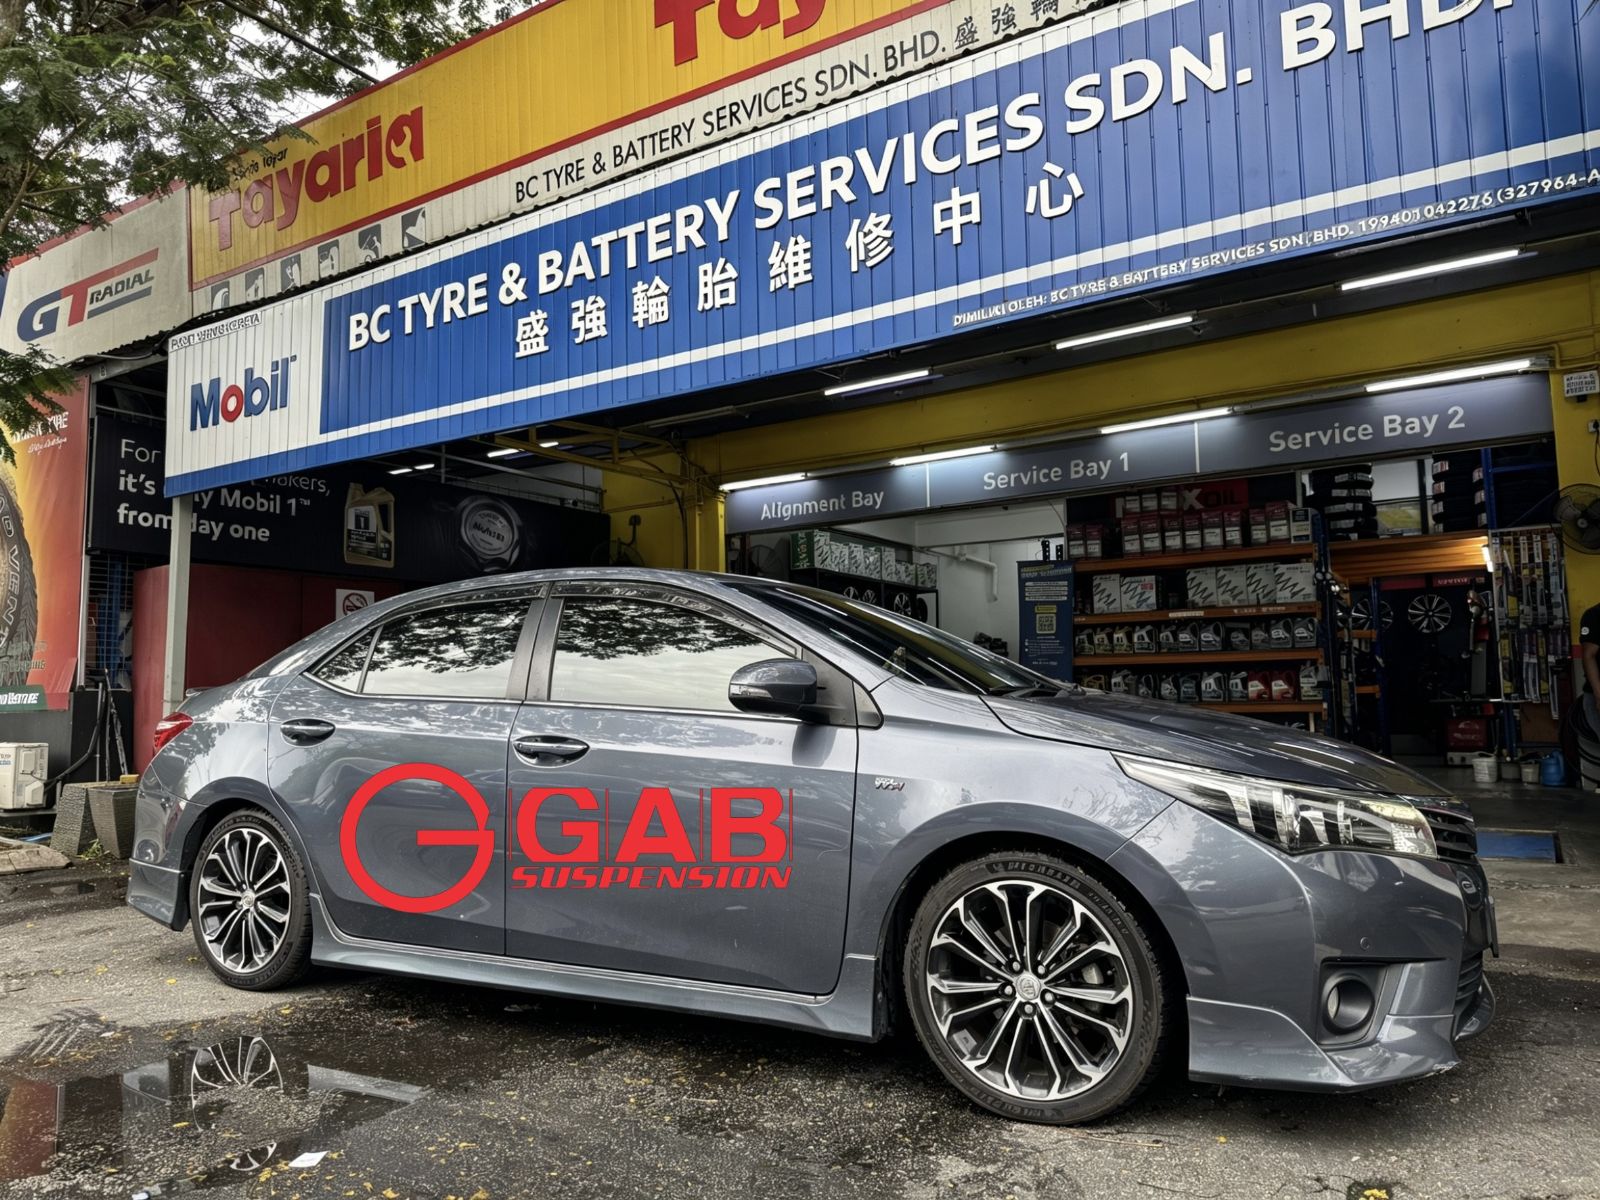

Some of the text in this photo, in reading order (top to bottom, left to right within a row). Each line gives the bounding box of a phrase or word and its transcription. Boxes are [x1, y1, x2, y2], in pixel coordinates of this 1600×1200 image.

[516, 175, 539, 202] BC
[543, 158, 586, 193] TYRE
[592, 152, 607, 174] &
[613, 118, 696, 171] BATTERY
[703, 78, 807, 137] SERVICES
[815, 54, 877, 97] SDN.
[884, 30, 946, 72] BHD.
[209, 105, 425, 251] Tayaria
[348, 304, 391, 351] BC
[399, 273, 489, 335] TYRE
[499, 262, 528, 305] &
[538, 190, 741, 295] BATTERY
[754, 93, 1044, 229] SERVICES
[1065, 32, 1253, 134] SDN.
[515, 162, 1086, 359] 盛強輪胎維修中心
[1008, 296, 1047, 313] OLEH:
[1051, 288, 1068, 303] BC
[1070, 279, 1107, 298] TYRE
[1109, 276, 1119, 288] &
[1123, 260, 1188, 286] BATTERY
[1191, 243, 1265, 269] SERVICES
[89, 269, 154, 305] RADIAL
[190, 356, 290, 432] Mobil
[120, 438, 161, 463] For
[1269, 405, 1466, 452] Service Bay 2
[118, 469, 156, 495] it's
[220, 487, 280, 514] Mobil
[983, 451, 1129, 490] Service Bay 1
[117, 503, 173, 529] from
[229, 524, 270, 542] one
[760, 490, 885, 521] Alignment Bay
[515, 786, 789, 863] GAB
[511, 865, 793, 889] SUSPENSION
